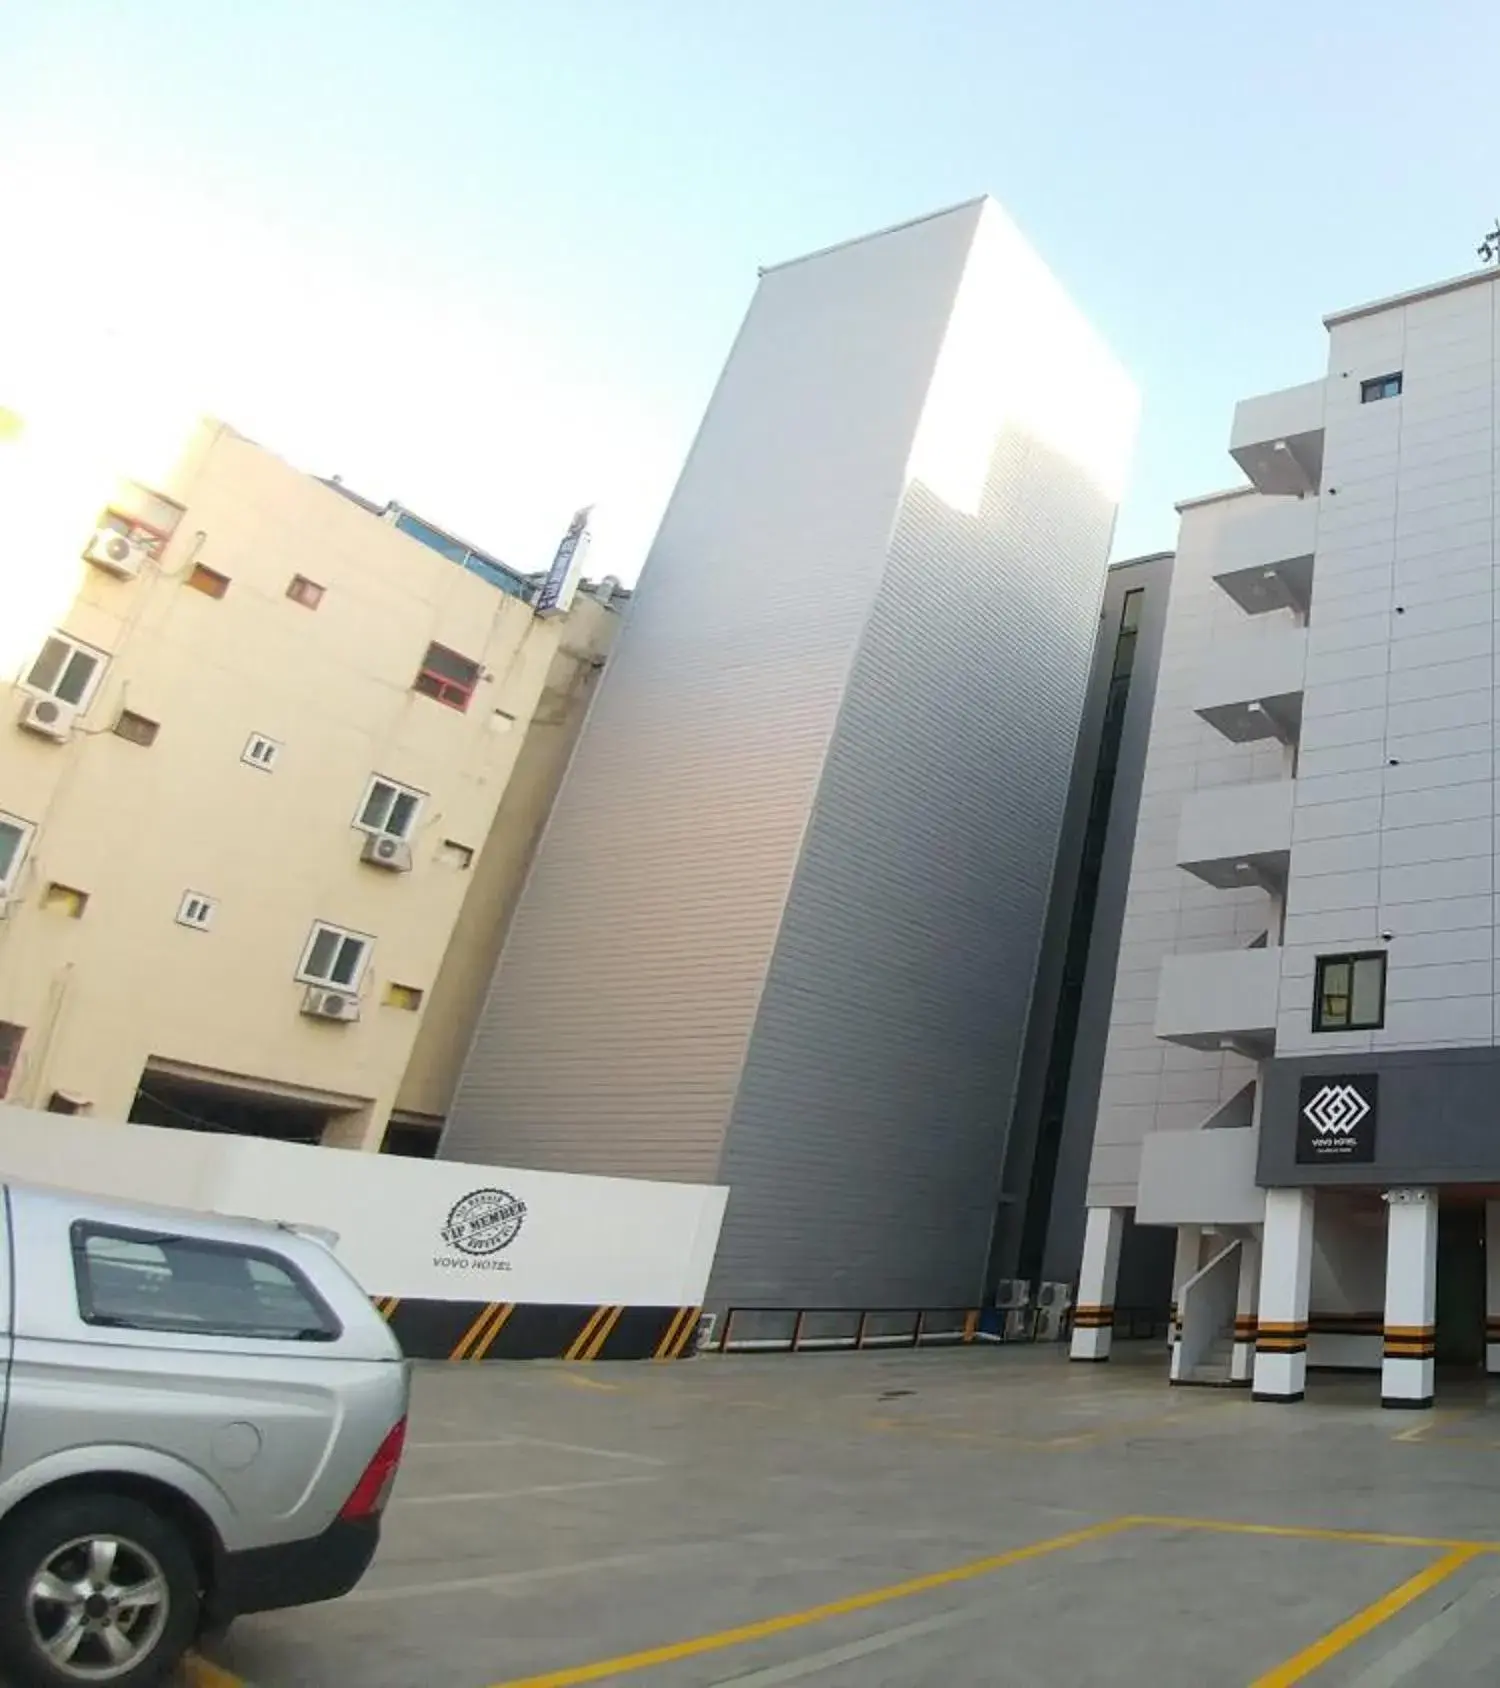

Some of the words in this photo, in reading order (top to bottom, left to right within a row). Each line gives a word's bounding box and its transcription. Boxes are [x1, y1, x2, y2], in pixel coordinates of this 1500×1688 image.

[440, 1224, 465, 1242] VIP
[469, 1201, 527, 1231] MEMBER
[433, 1257, 469, 1269] VOVO
[471, 1260, 512, 1271] HOTEL
